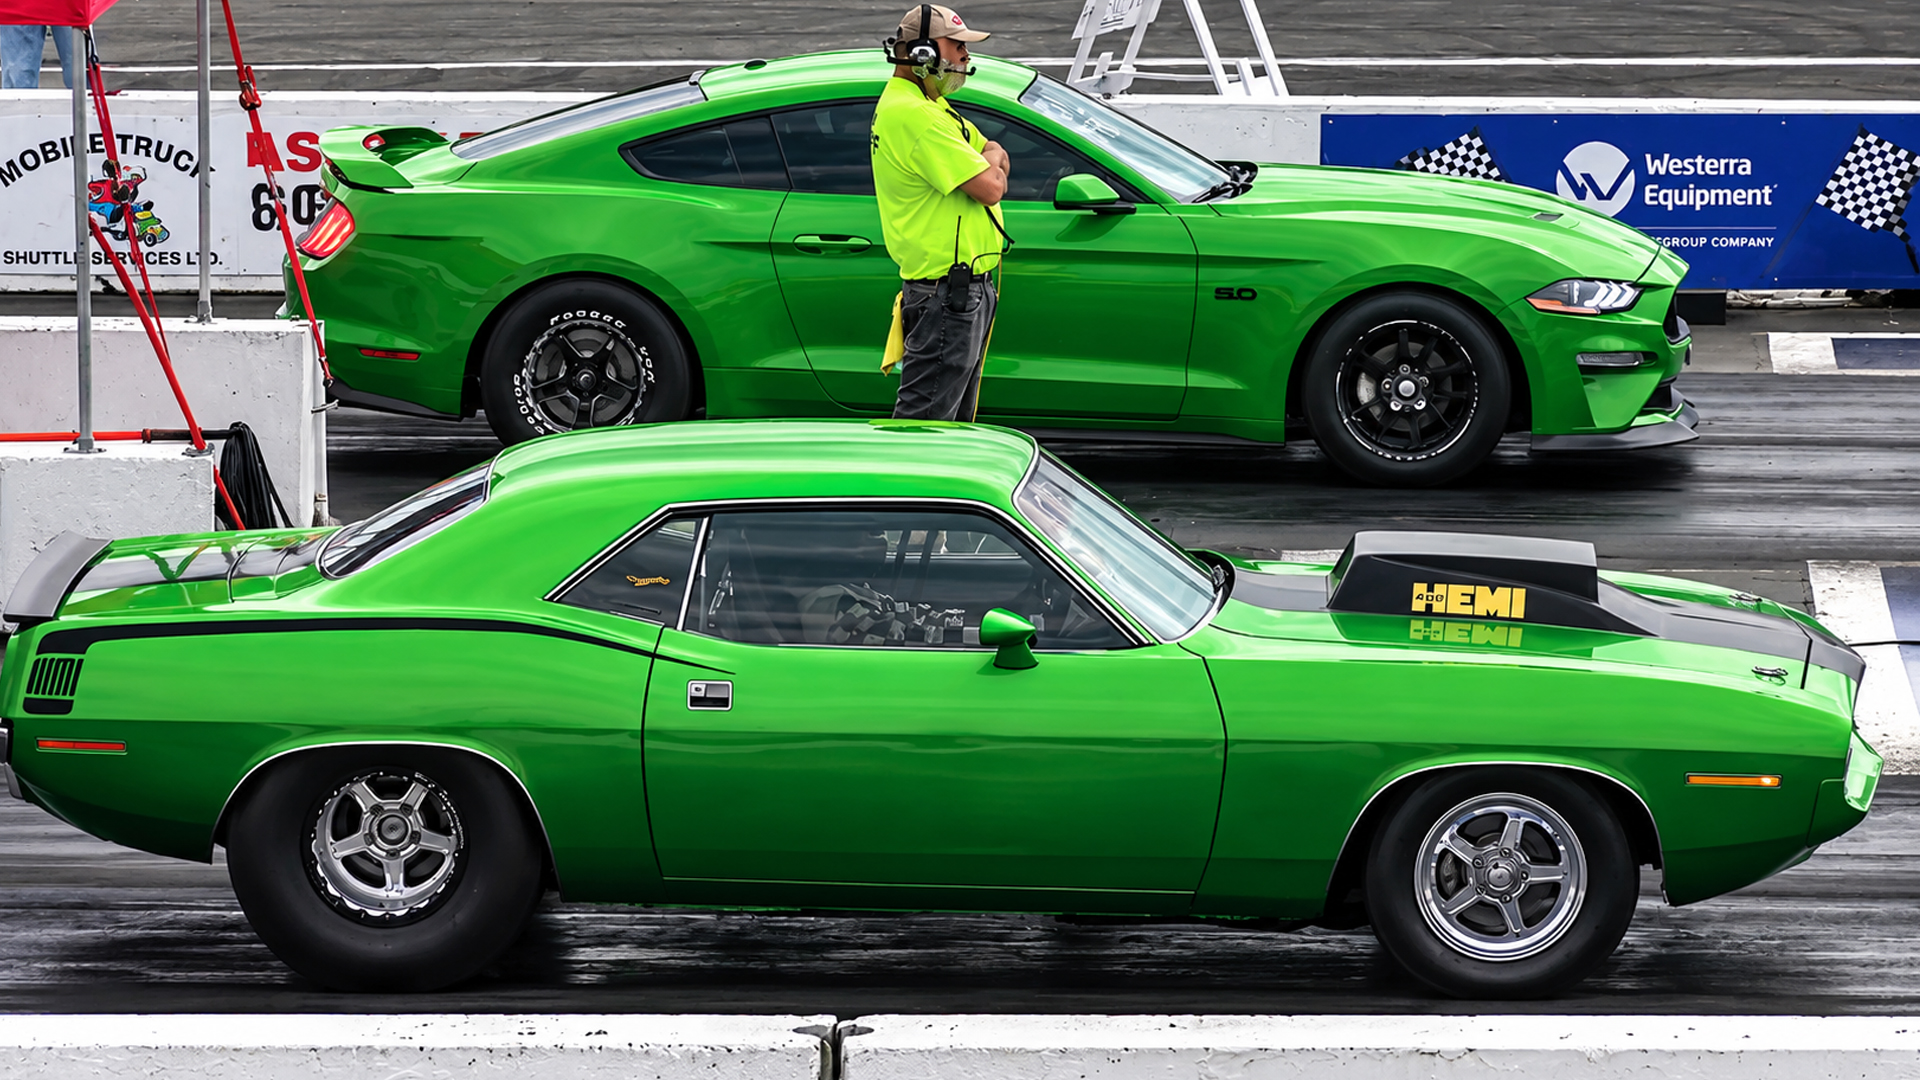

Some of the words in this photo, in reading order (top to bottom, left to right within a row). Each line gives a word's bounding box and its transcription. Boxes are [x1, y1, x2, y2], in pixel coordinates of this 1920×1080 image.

[1645, 153, 1752, 176] Westerra
[1645, 184, 1773, 211] Equipment
[1711, 236, 1775, 248] COMPANY
[3, 250, 84, 265] SHUTTL
[91, 251, 181, 266] SERVCES
[1214, 286, 1258, 301] 5.0
[1411, 582, 1527, 619] HEMI
